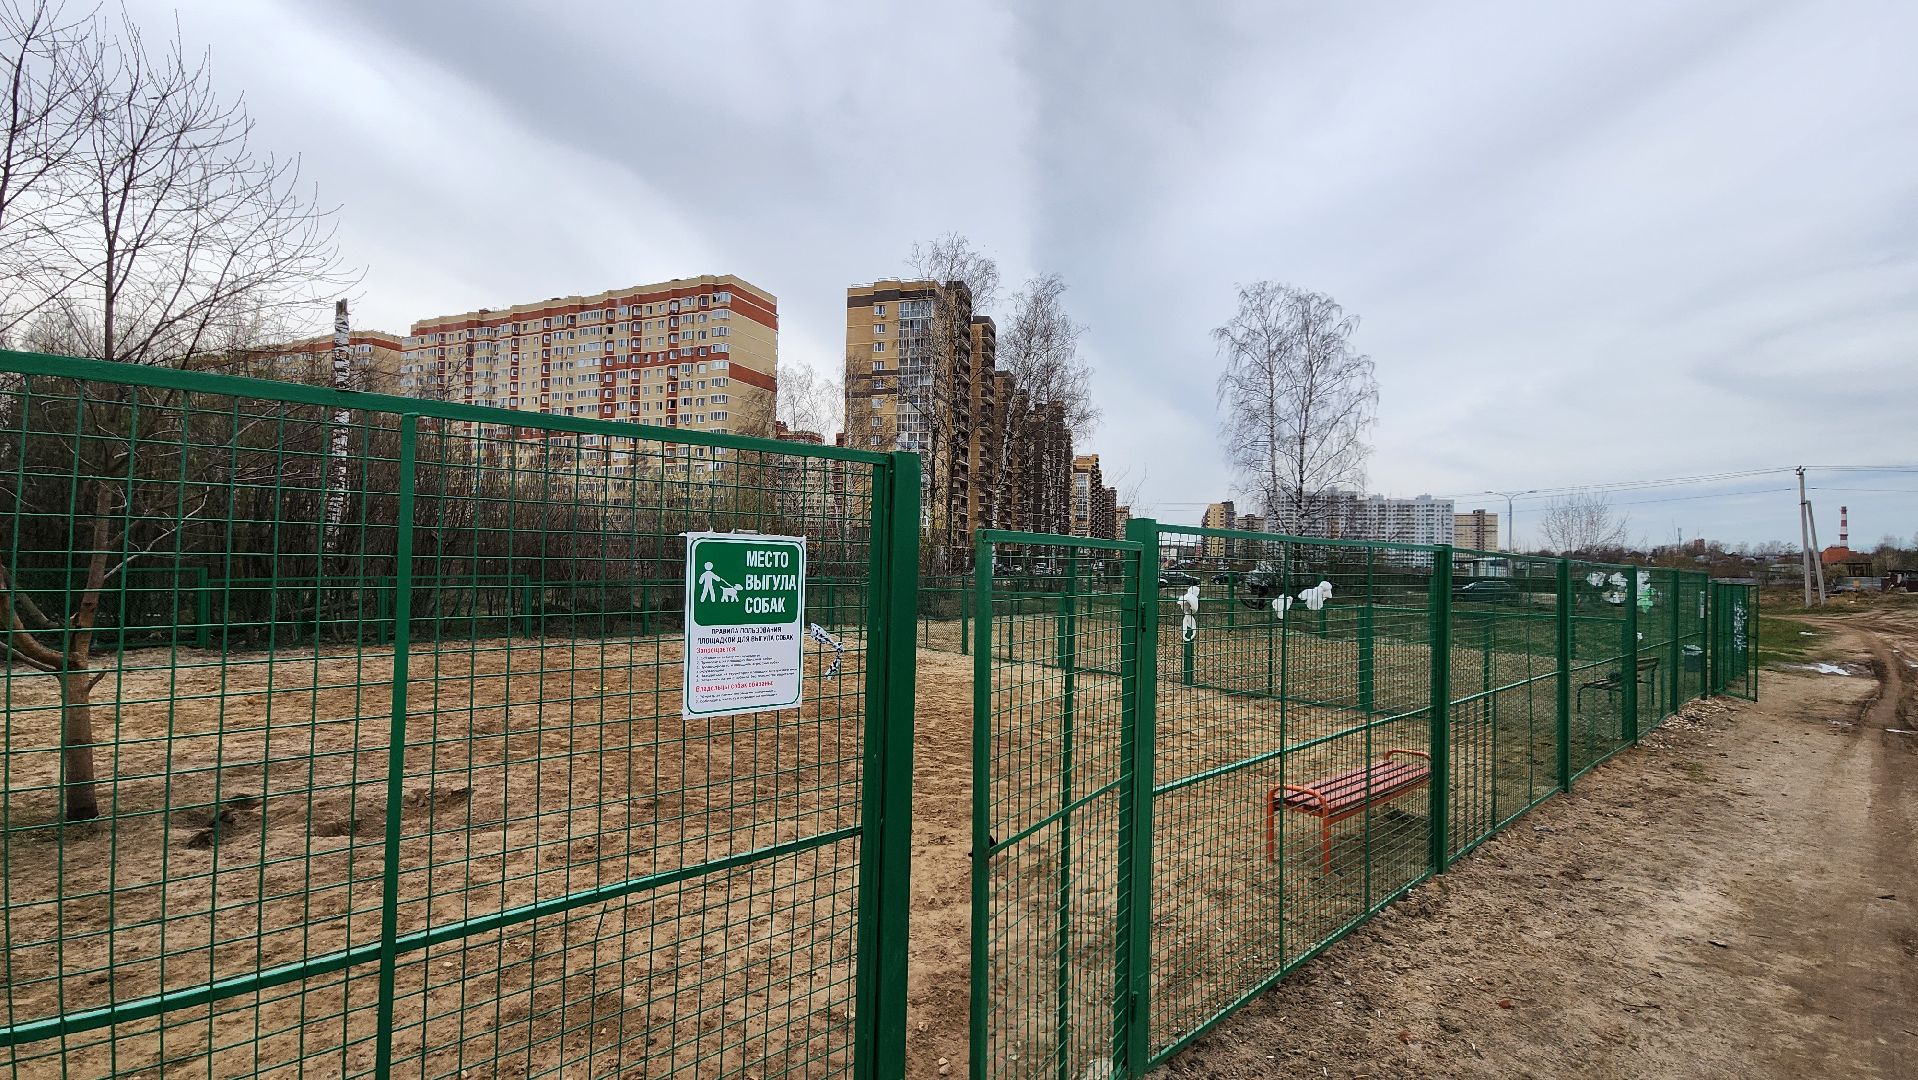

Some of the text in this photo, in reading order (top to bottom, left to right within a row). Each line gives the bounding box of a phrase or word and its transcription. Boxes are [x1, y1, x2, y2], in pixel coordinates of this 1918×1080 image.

[746, 550, 789, 568] МЕСТО
[745, 574, 797, 591] ВЫГУЛА
[744, 597, 786, 614] СОБАК
[711, 626, 782, 635] ПРАВИЛА ПОЛЬЗОВАНИЯ
[697, 634, 794, 645] ПЛОЩАДКОЙ ДЛЯ ВЫГУЛА СОБАК
